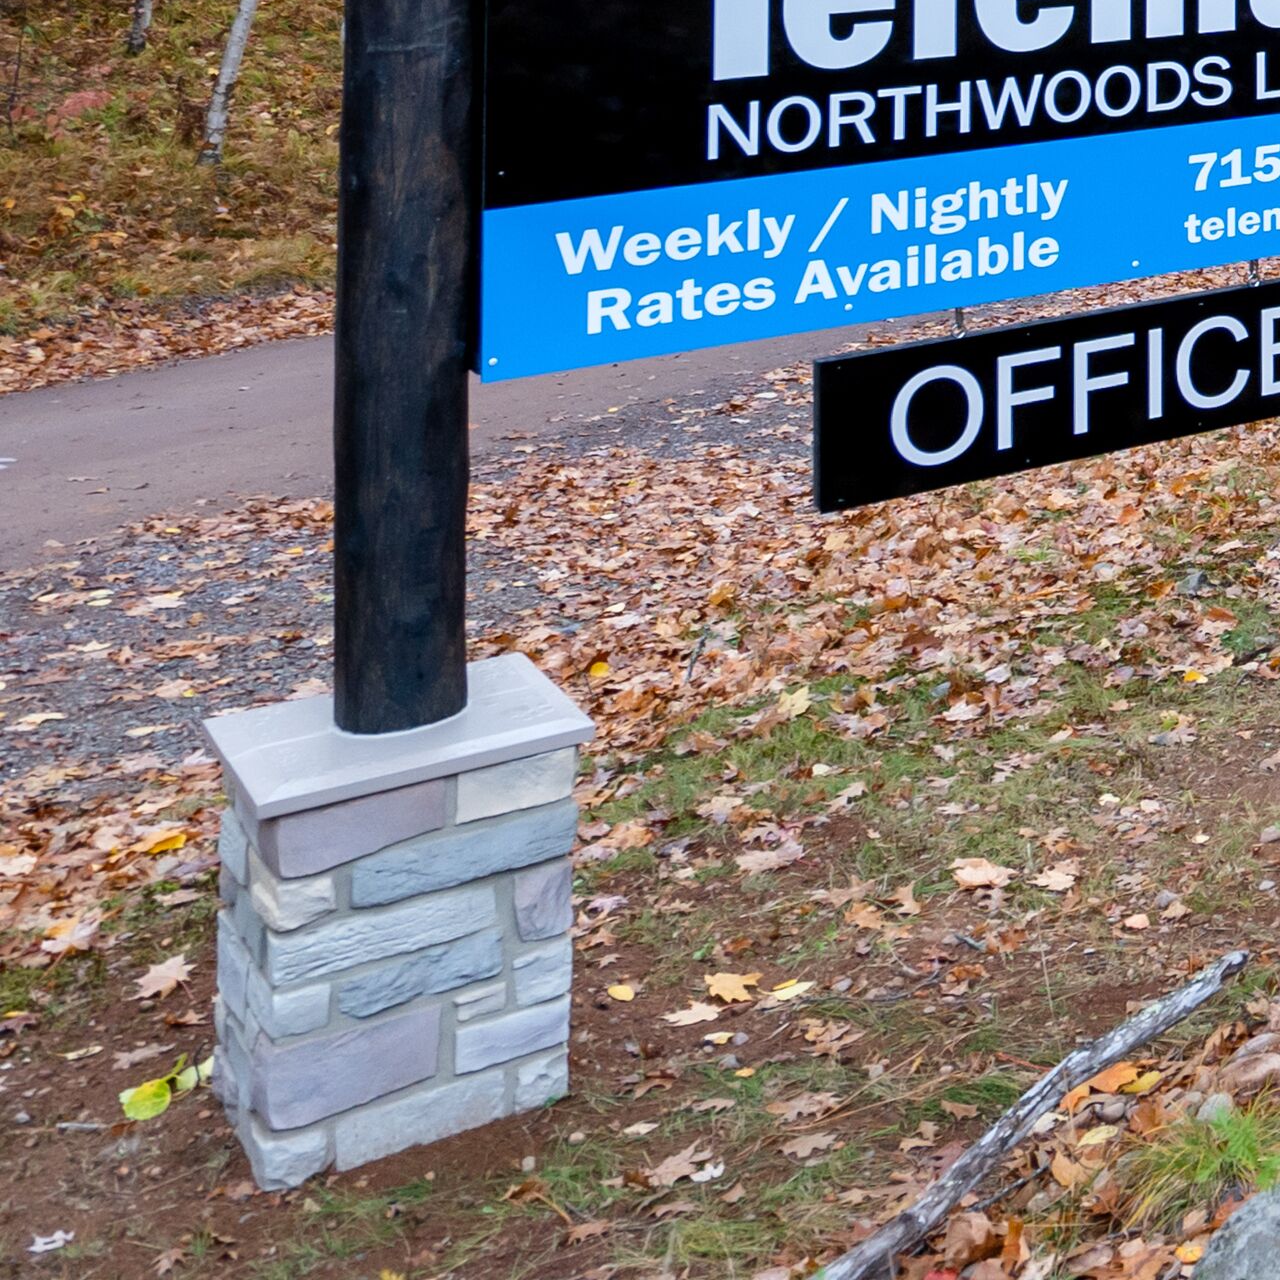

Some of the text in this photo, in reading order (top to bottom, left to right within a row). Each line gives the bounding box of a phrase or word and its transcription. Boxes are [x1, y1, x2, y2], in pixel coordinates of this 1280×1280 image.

[706, 56, 1232, 160] NORTHWOODS
[556, 208, 796, 275] Weekly
[869, 174, 1068, 234] Nightly
[586, 231, 1060, 334] Rates Available
